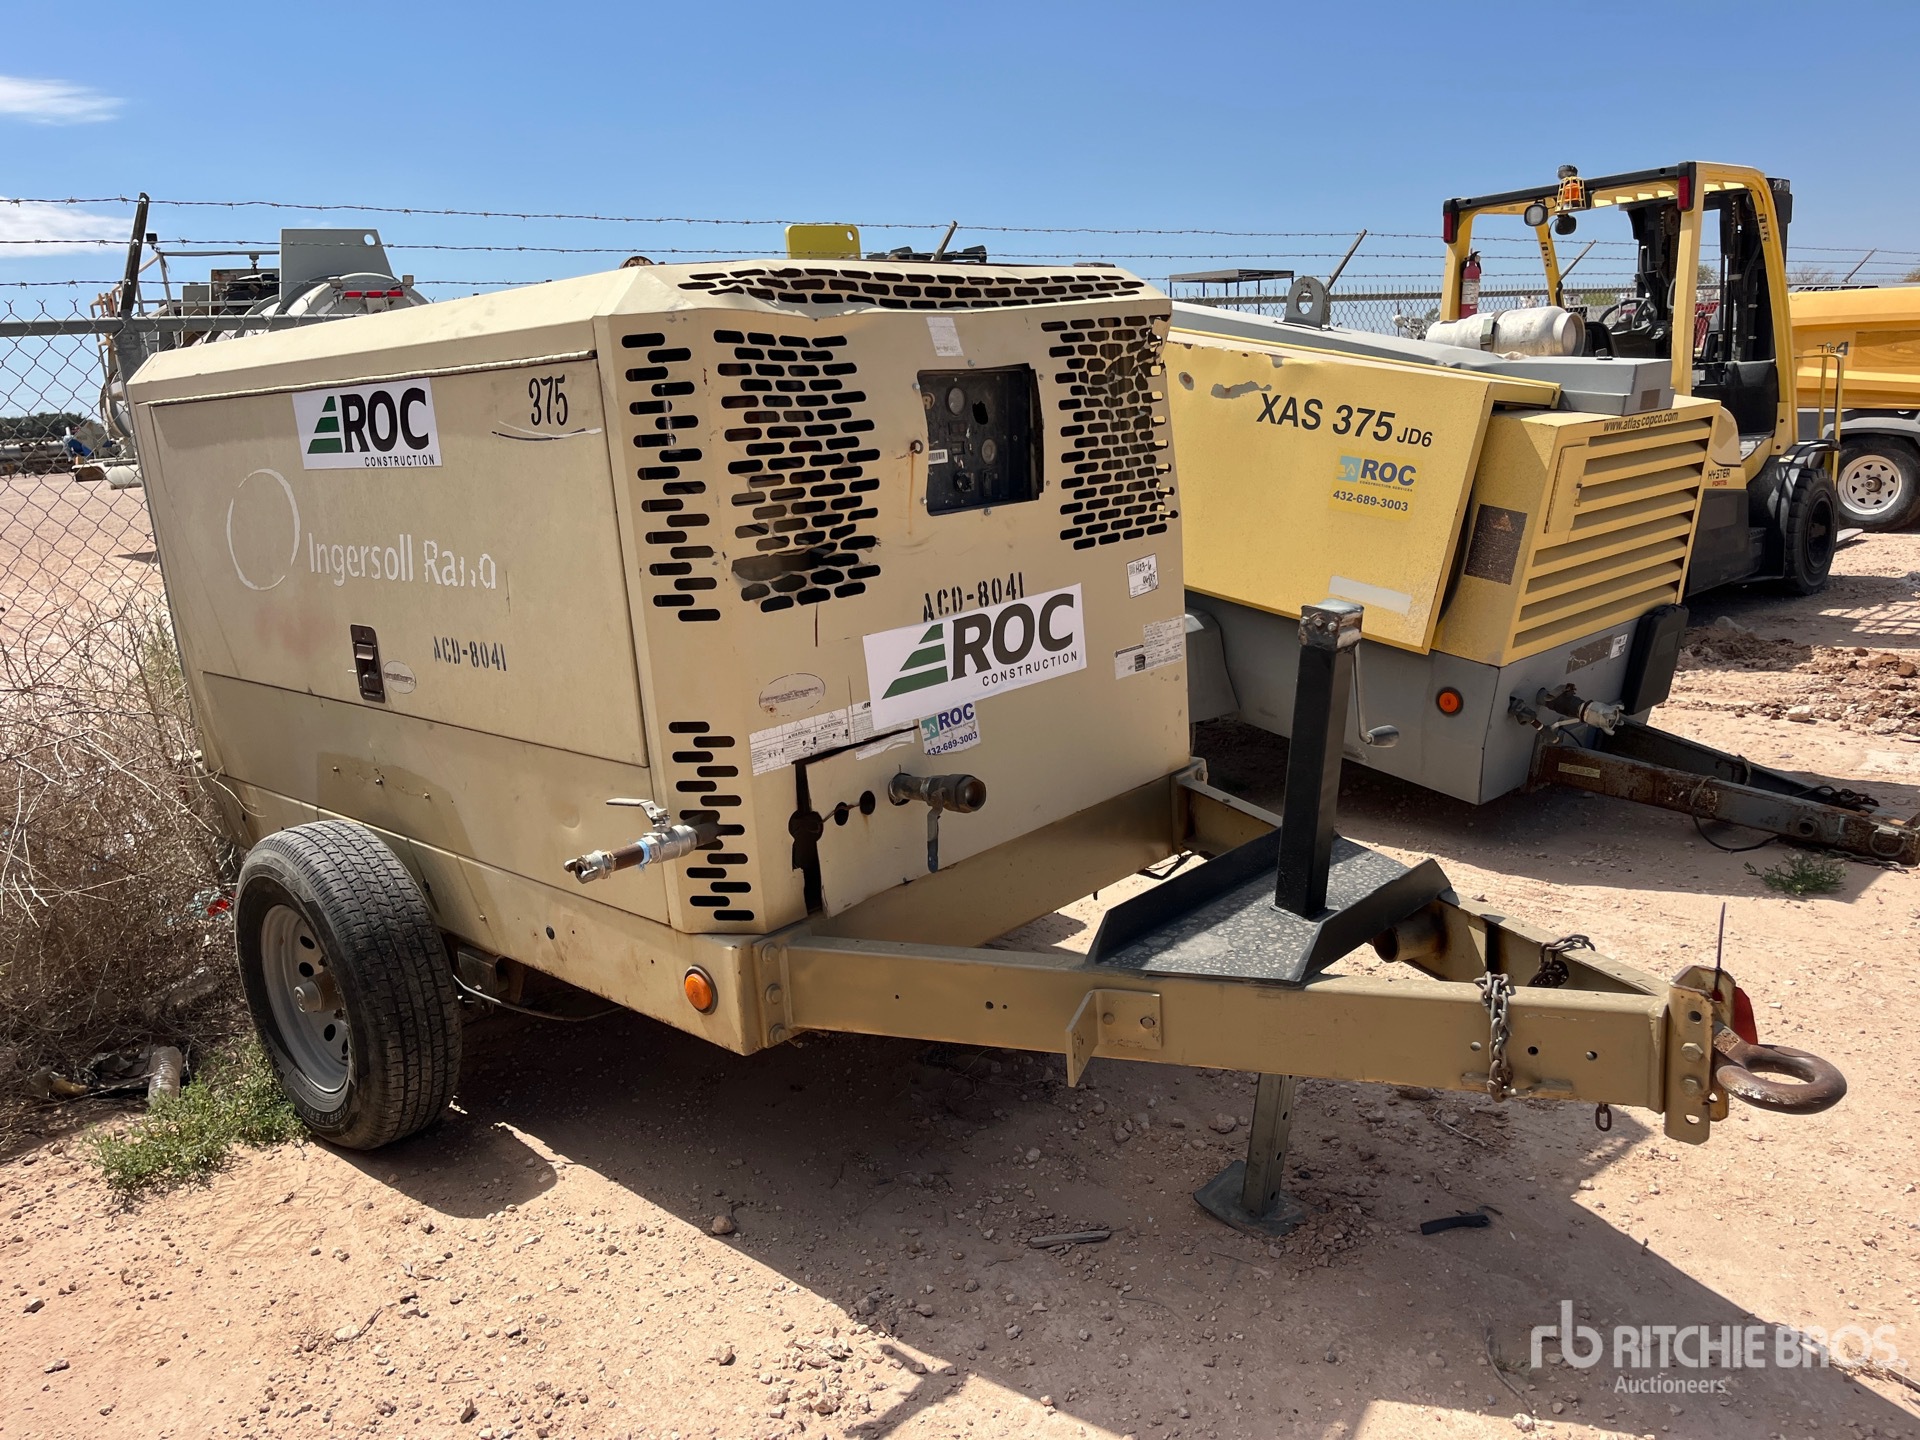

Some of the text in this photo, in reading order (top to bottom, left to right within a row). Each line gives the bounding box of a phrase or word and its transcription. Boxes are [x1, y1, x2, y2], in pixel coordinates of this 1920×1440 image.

[528, 374, 568, 426] 375
[339, 387, 430, 453] ROC
[1256, 393, 1433, 447] XAS 375 JD6
[364, 454, 435, 467] CONSTRUCTION
[1360, 459, 1417, 486] ROC
[1707, 468, 1731, 480] HYSTER
[1332, 490, 1409, 512] 432-689-3003
[308, 532, 414, 587] Ingersoll
[923, 571, 1024, 622] ACD-8041
[433, 635, 507, 671] ACD-8041
[950, 593, 1075, 682] ROC
[982, 651, 1078, 687] CONSTRUCTION
[937, 703, 975, 731] ROC
[926, 731, 978, 756] 432-689-3003
